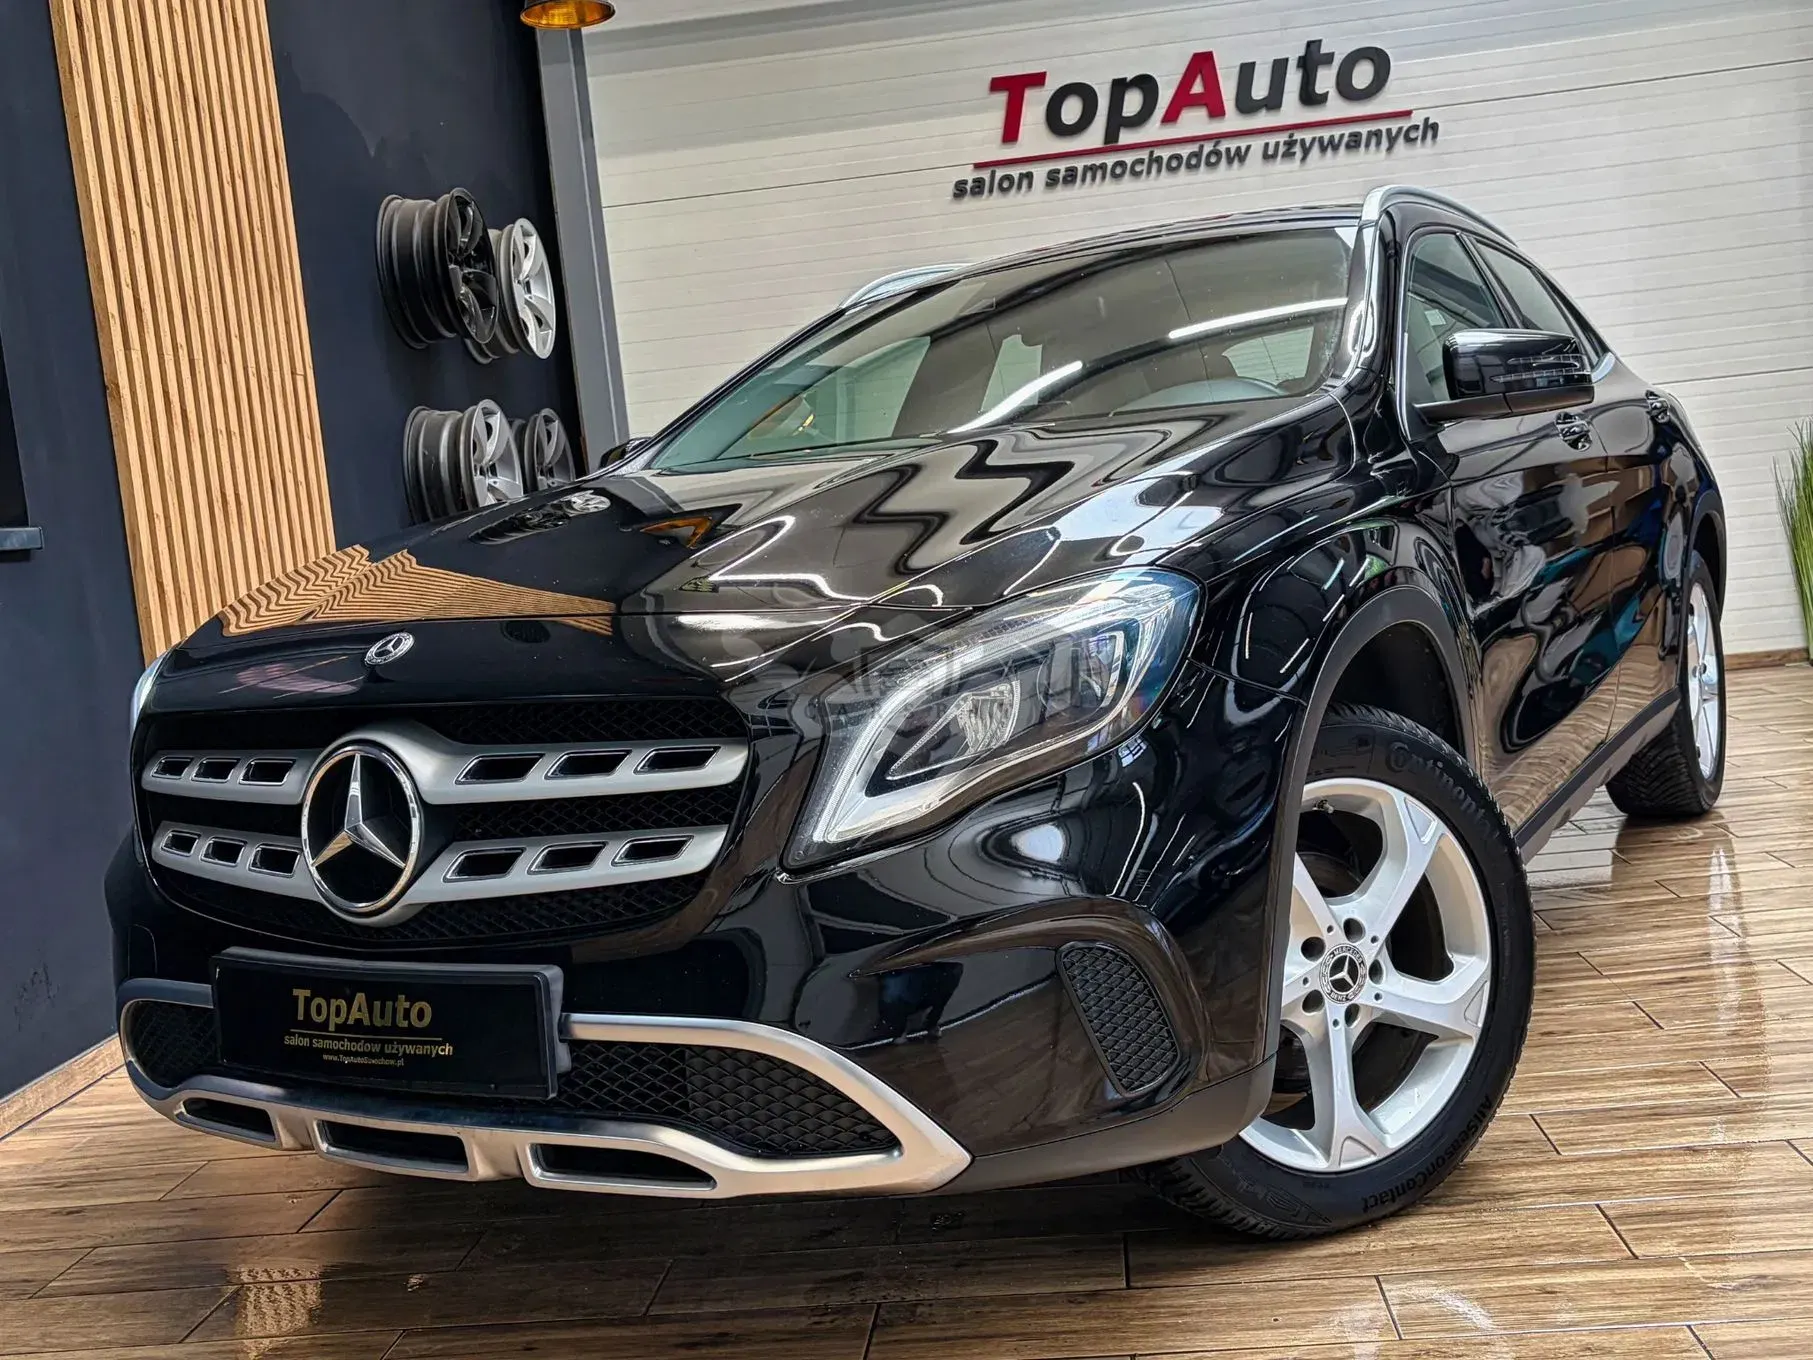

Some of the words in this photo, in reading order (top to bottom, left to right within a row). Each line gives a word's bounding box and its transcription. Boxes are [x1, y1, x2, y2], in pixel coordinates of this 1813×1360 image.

[989, 39, 1391, 145] TopAuto
[953, 169, 1034, 198] salon
[1046, 140, 1251, 188] samochodów
[1262, 117, 1440, 161] używanych
[292, 988, 432, 1032] TopAuto
[284, 1033, 310, 1047] salon
[384, 1041, 453, 1058] używanych
